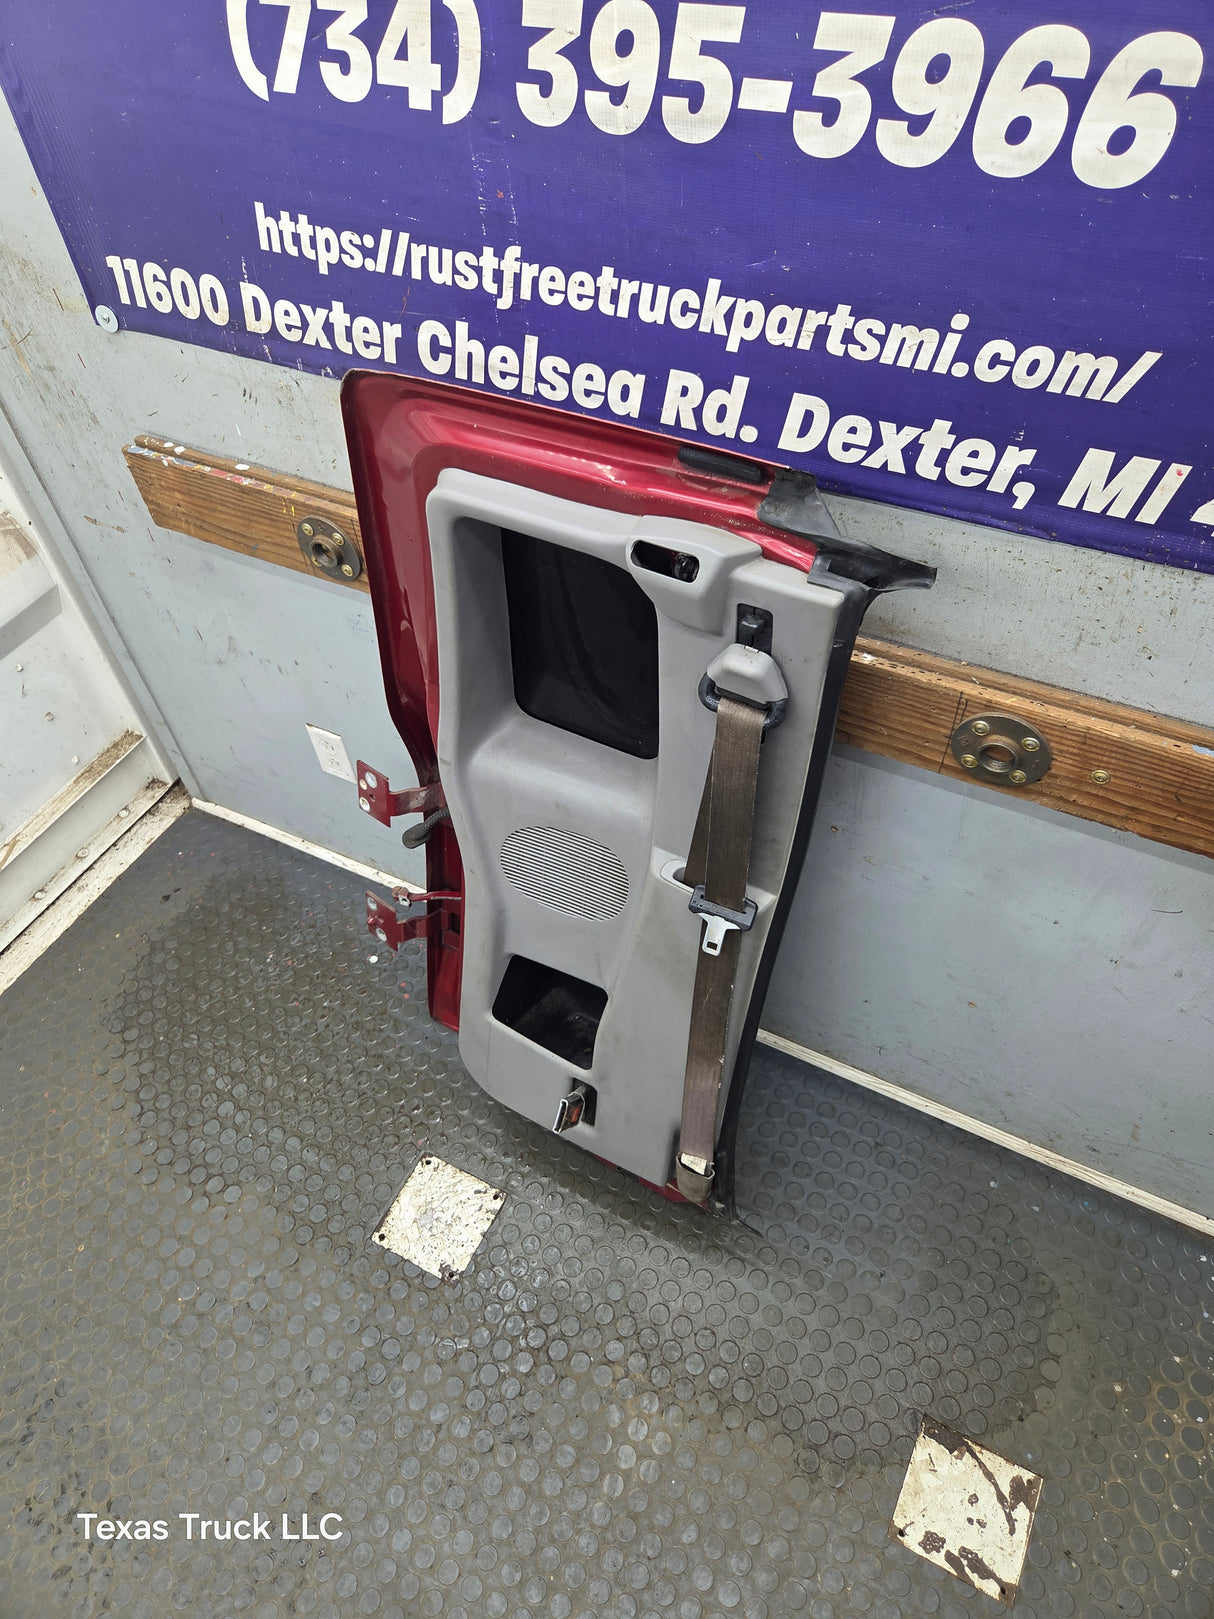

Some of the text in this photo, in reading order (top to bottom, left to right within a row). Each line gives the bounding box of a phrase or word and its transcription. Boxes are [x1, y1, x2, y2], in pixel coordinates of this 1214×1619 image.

[225, 0, 1204, 190] (734) 395-3966
[105, 255, 230, 326] 11600
[240, 280, 403, 365] Dexter
[417, 319, 646, 419] Chelsea
[659, 368, 759, 443] Rd.
[777, 392, 1038, 510] Dexter,
[1057, 447, 1193, 525] MI
[253, 201, 1163, 404] https://rustfreetruckpartsmi.com/
